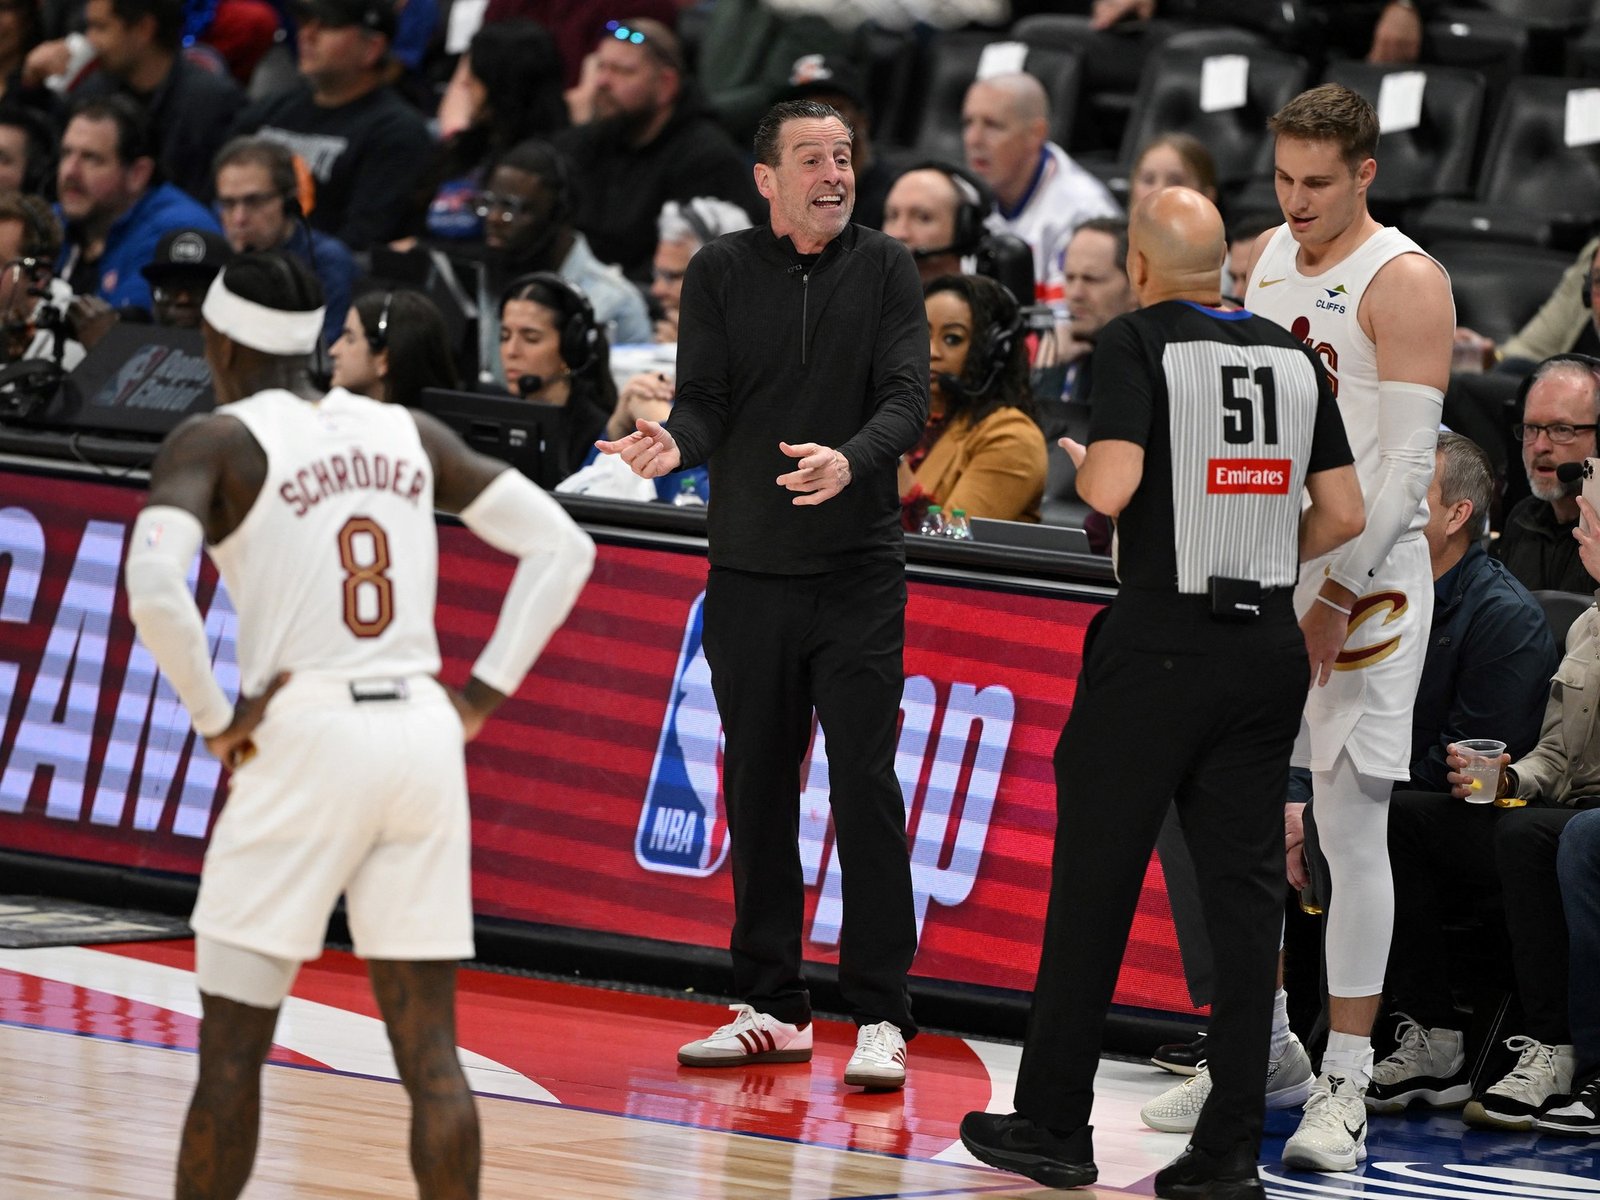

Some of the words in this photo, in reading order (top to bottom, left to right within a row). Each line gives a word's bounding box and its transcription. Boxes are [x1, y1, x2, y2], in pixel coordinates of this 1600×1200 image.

[1315, 299, 1346, 315] CLIFFS
[1221, 365, 1278, 445] 51
[279, 447, 425, 518] SCHRÖDER
[1215, 466, 1284, 485] Emirates
[338, 515, 394, 639] 8
[649, 806, 698, 855] NBA
